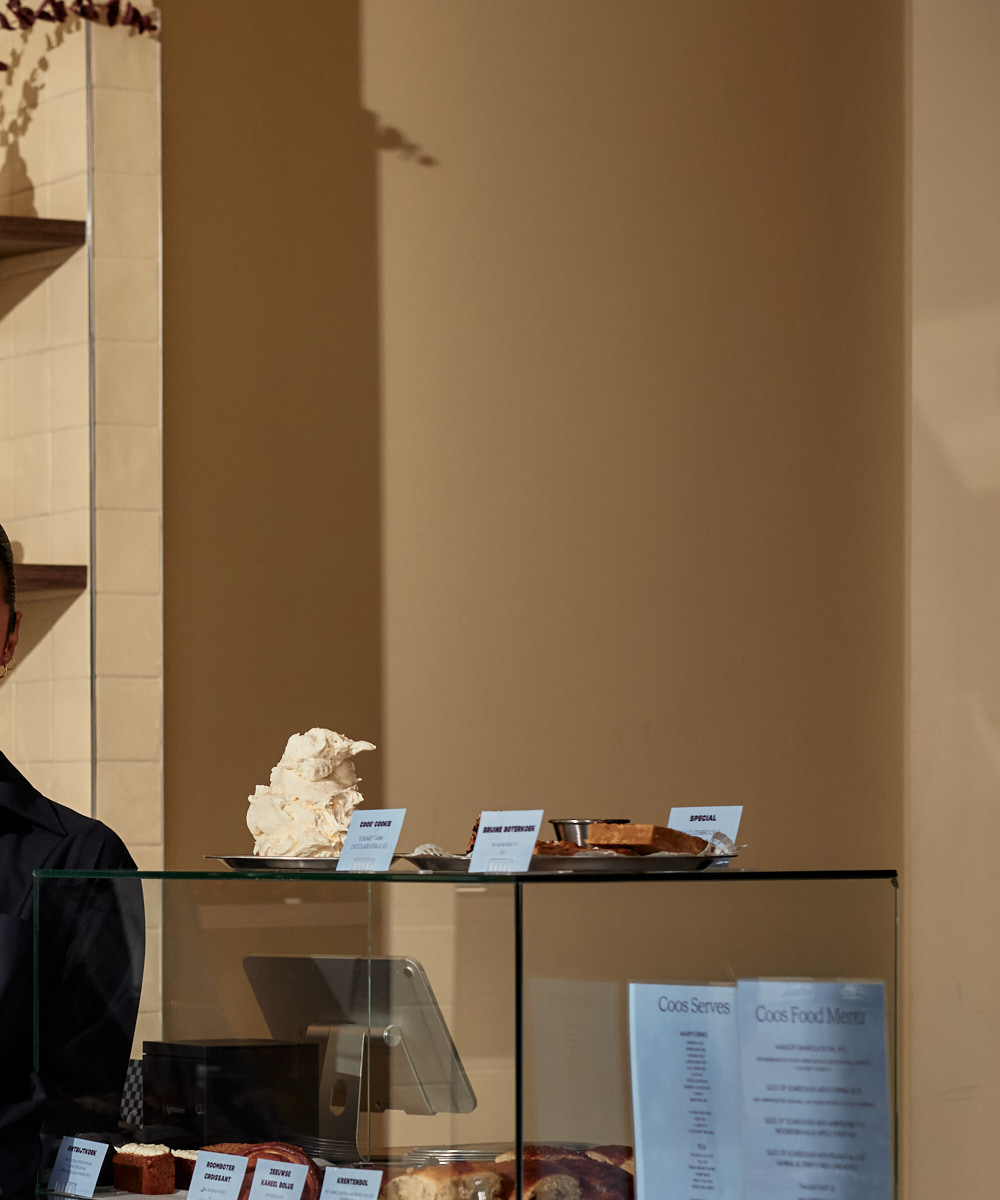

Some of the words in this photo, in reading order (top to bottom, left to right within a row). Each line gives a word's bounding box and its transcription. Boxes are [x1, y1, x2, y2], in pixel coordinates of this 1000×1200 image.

[658, 995, 689, 1013] Coos
[691, 997, 731, 1014] Serves
[755, 1005, 789, 1023] Coos
[790, 1006, 824, 1024] Food
[825, 1007, 866, 1025] Menu
[206, 1161, 235, 1171] ROOMBOTER
[204, 1172, 232, 1183] CROISSANT
[269, 1168, 291, 1178] ZEEUWSE
[261, 1179, 278, 1188] KANEEL
[279, 1181, 294, 1190] BOLUS
